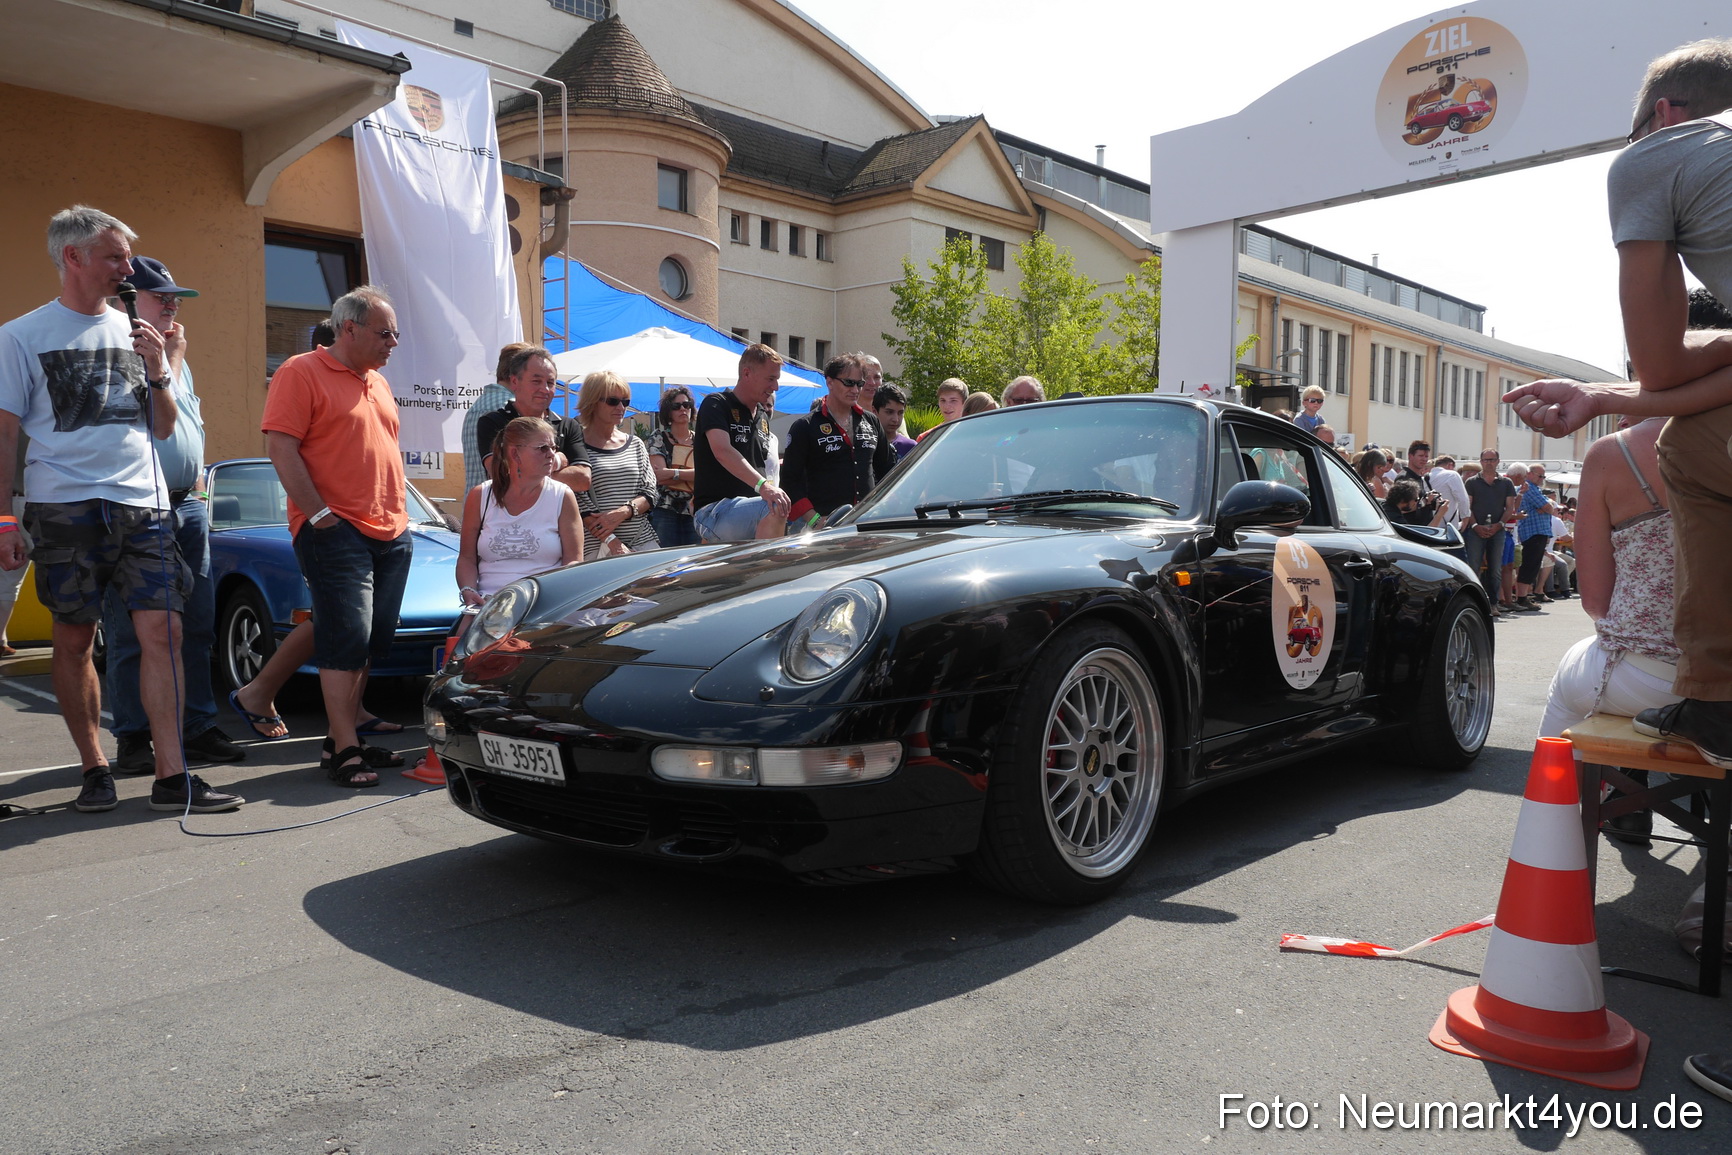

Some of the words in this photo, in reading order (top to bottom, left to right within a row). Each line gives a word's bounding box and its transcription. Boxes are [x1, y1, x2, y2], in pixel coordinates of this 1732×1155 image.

[1424, 22, 1472, 58] ZIEL
[1406, 46, 1491, 75] PORSCHE
[1436, 62, 1458, 75] 911
[362, 119, 495, 160] PORSCHE
[1427, 135, 1470, 150] JAHRE
[1408, 156, 1437, 167] MEILENSTEIN
[413, 384, 455, 397] Porsche
[457, 386, 484, 397] Zent
[394, 397, 473, 411] Nürnberg-Fürth
[730, 423, 751, 434] POR
[817, 435, 844, 446] POR
[825, 444, 842, 453] Polo
[422, 452, 442, 470] 41
[1287, 541, 1308, 569] 43
[1286, 577, 1321, 586] PORSCHE
[1295, 657, 1313, 665] JAHRE
[509, 743, 559, 776] 35951
